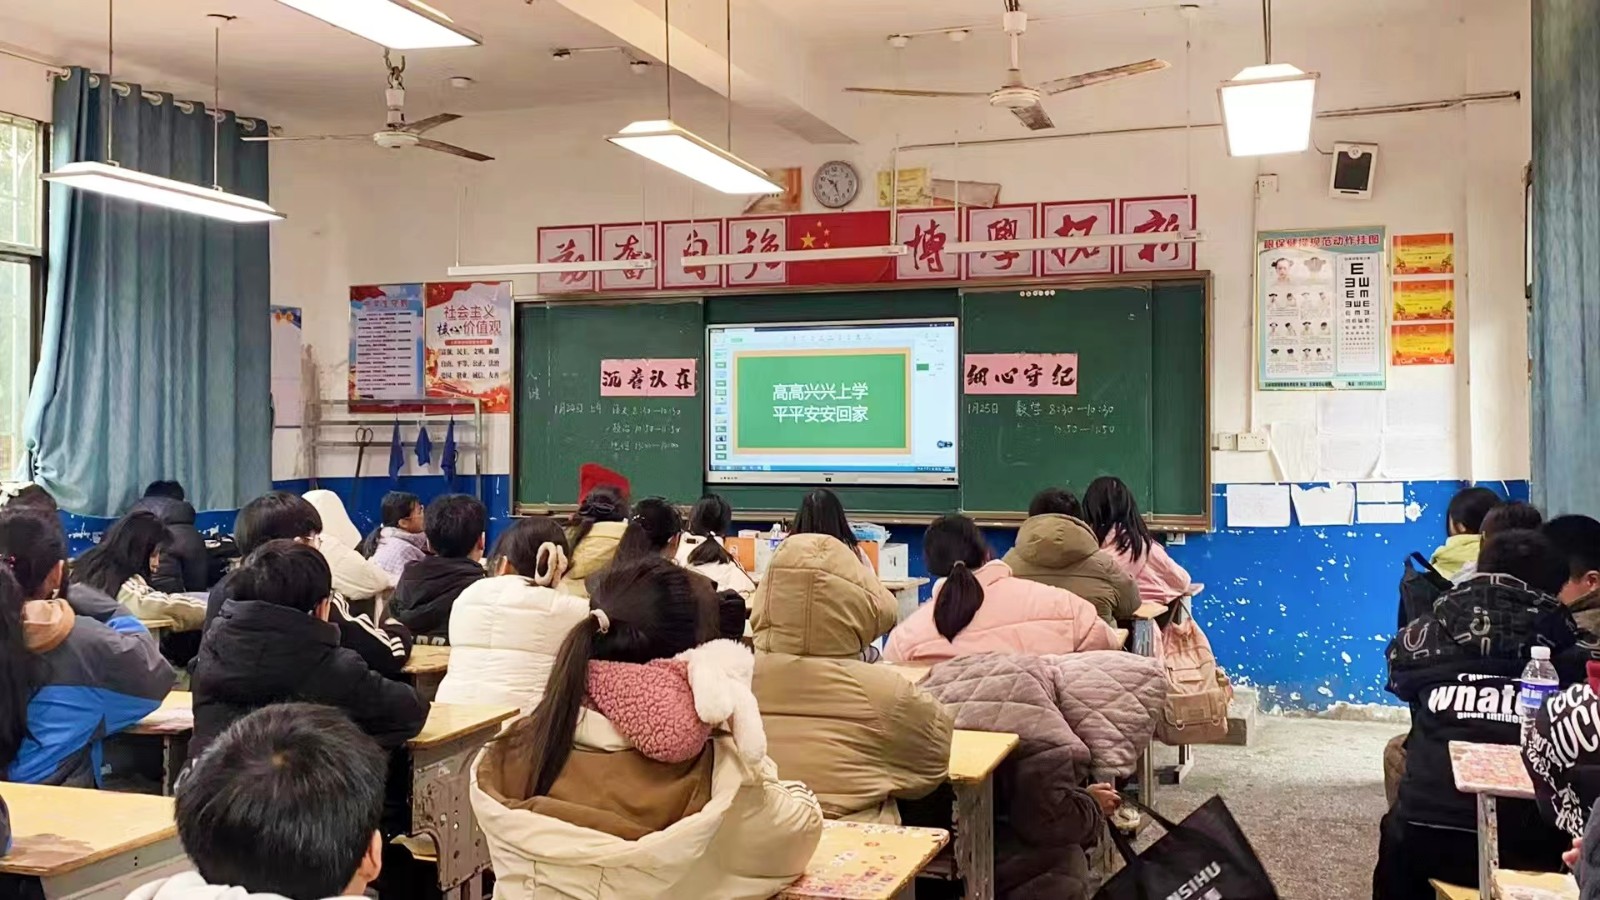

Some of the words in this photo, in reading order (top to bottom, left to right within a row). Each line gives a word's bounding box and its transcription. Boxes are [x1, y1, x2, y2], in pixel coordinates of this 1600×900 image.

[444, 305, 495, 320] 社会主义
[437, 320, 502, 337] 核心价值观
[966, 363, 1076, 388] 细心守纪
[772, 382, 869, 401] 高高兴兴上学
[772, 405, 869, 424] 平平安安回家
[1016, 401, 1042, 417] 数学
